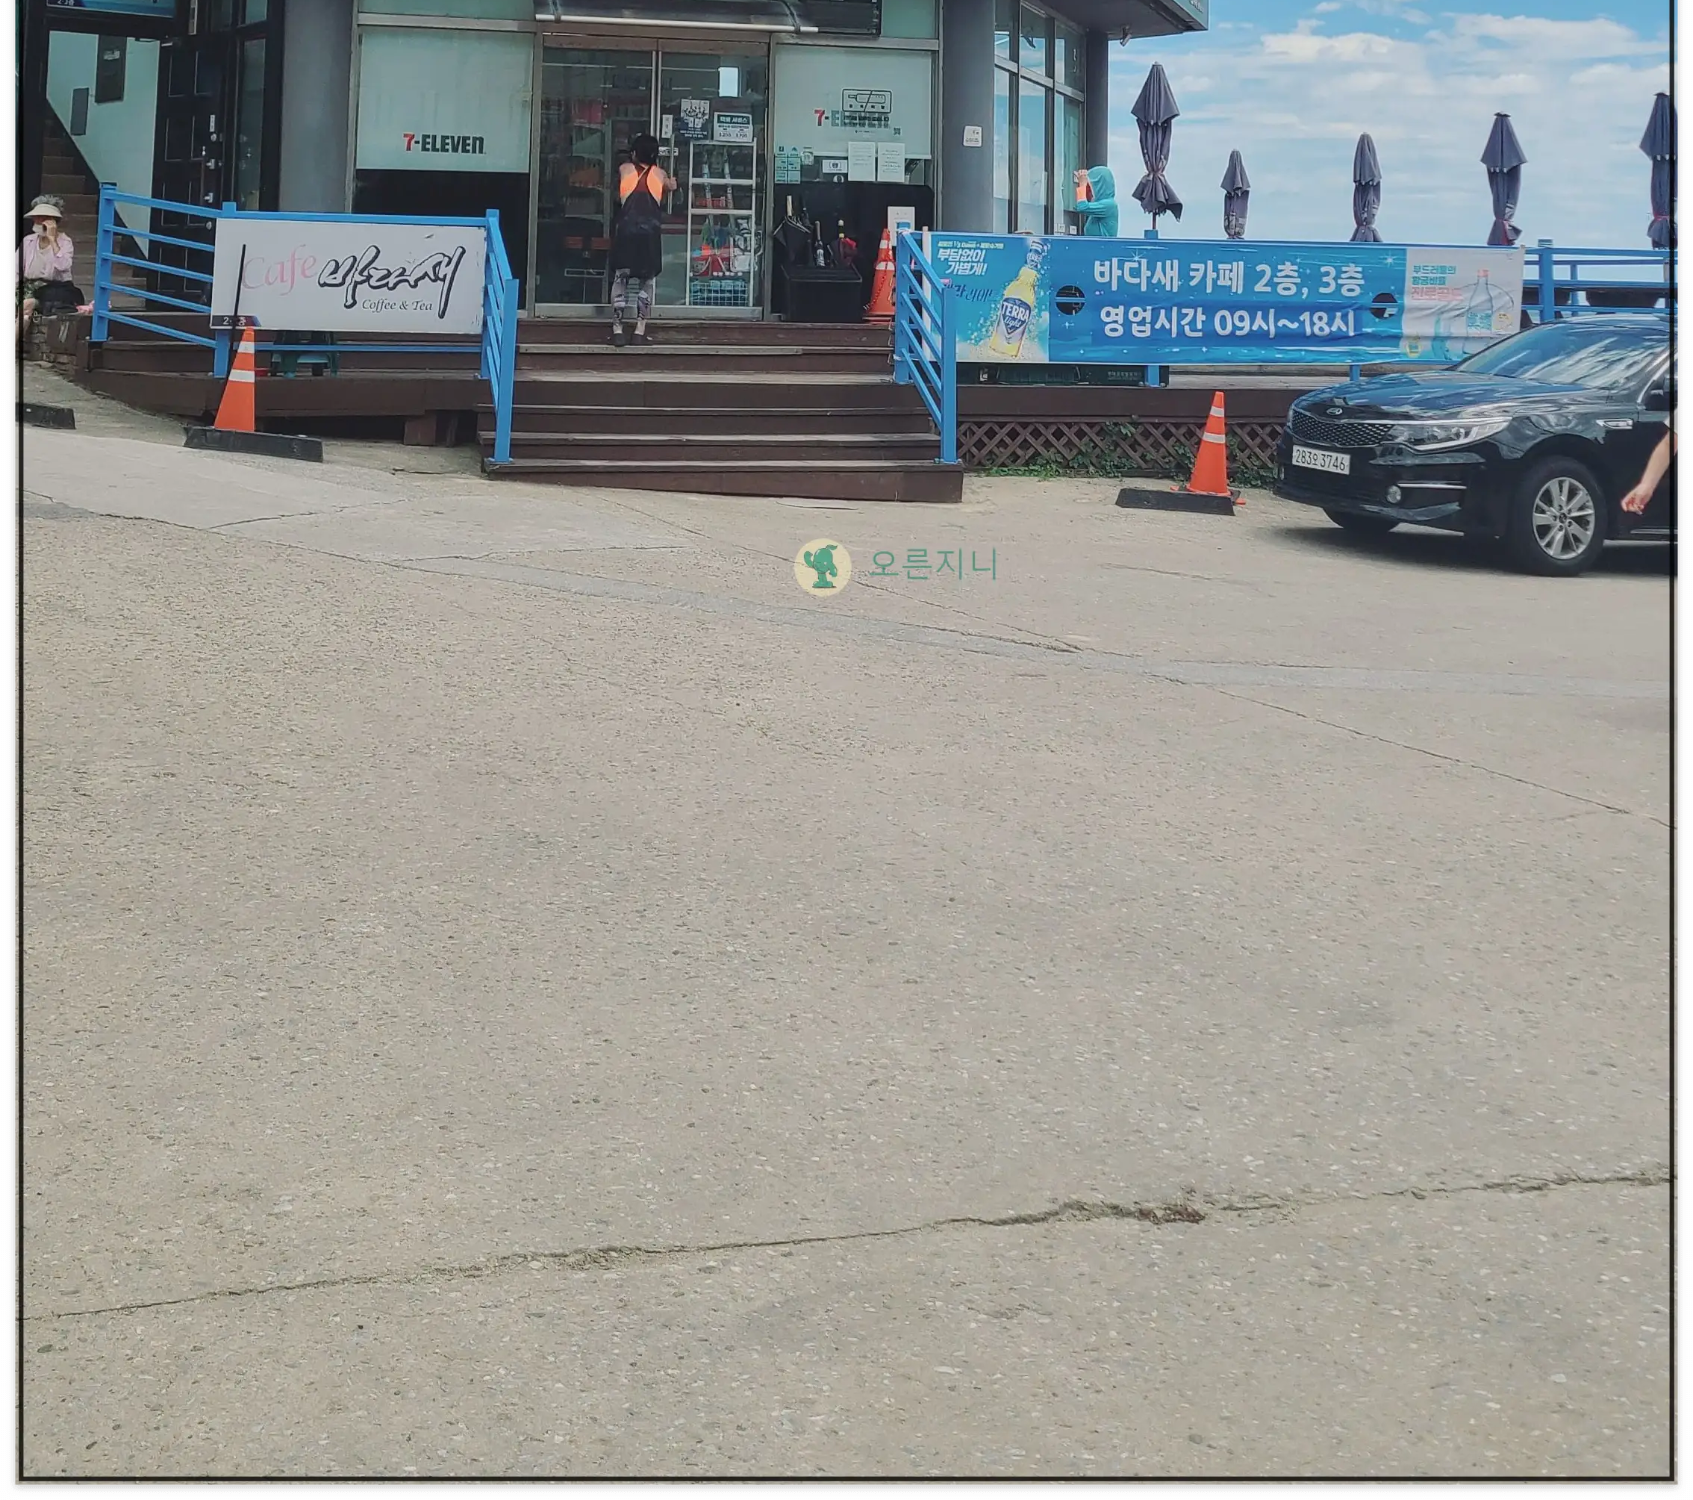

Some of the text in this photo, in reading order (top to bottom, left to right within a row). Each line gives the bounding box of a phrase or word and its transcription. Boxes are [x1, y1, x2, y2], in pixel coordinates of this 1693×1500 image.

[937, 248, 986, 262] 부담없이
[241, 244, 318, 296] Cafe
[945, 261, 988, 276] 가볍게!
[1094, 257, 1365, 299] 바다새 카페 2층, 3층
[362, 297, 433, 314] Coffee & Tea
[1002, 301, 1030, 322] TERRA
[1100, 305, 1355, 339] 영업시간 09시~18시
